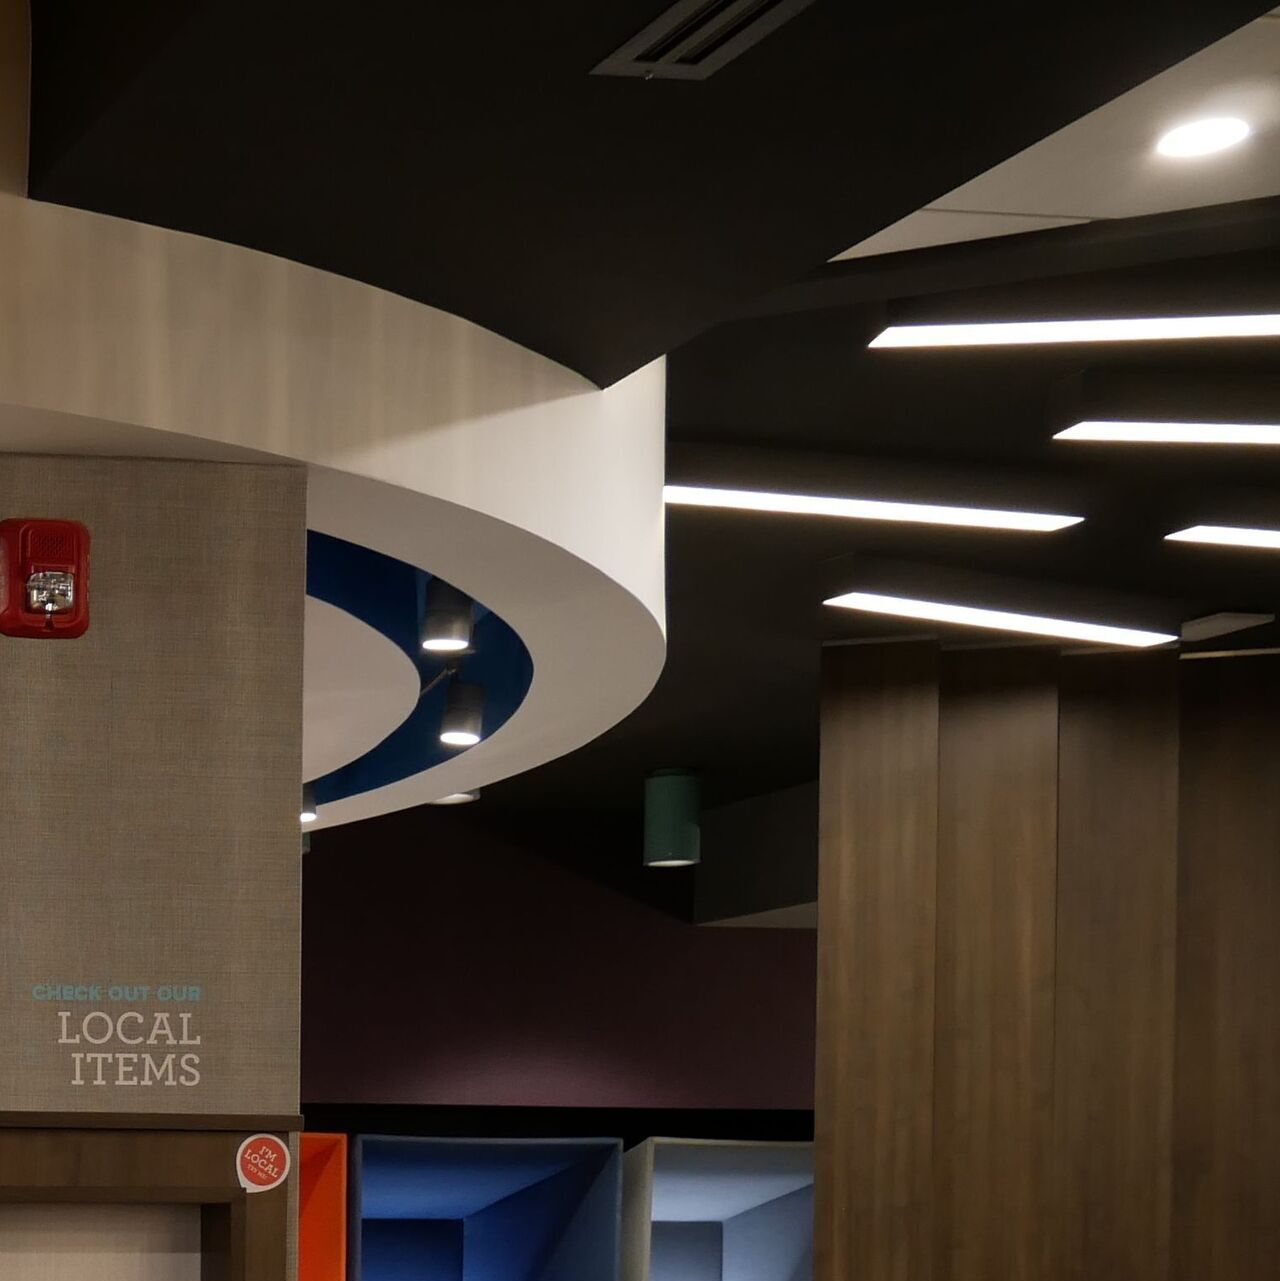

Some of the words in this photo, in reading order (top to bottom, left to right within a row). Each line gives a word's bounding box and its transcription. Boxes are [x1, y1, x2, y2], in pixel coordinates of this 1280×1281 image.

[31, 984, 101, 1001] CHECK
[108, 985, 151, 1001] OUT
[157, 986, 202, 1001] OUR
[57, 1011, 201, 1045] LOCAL
[71, 1053, 201, 1086] ITEMS
[244, 1148, 279, 1178] LOCAL
[259, 1145, 278, 1162] I'M
